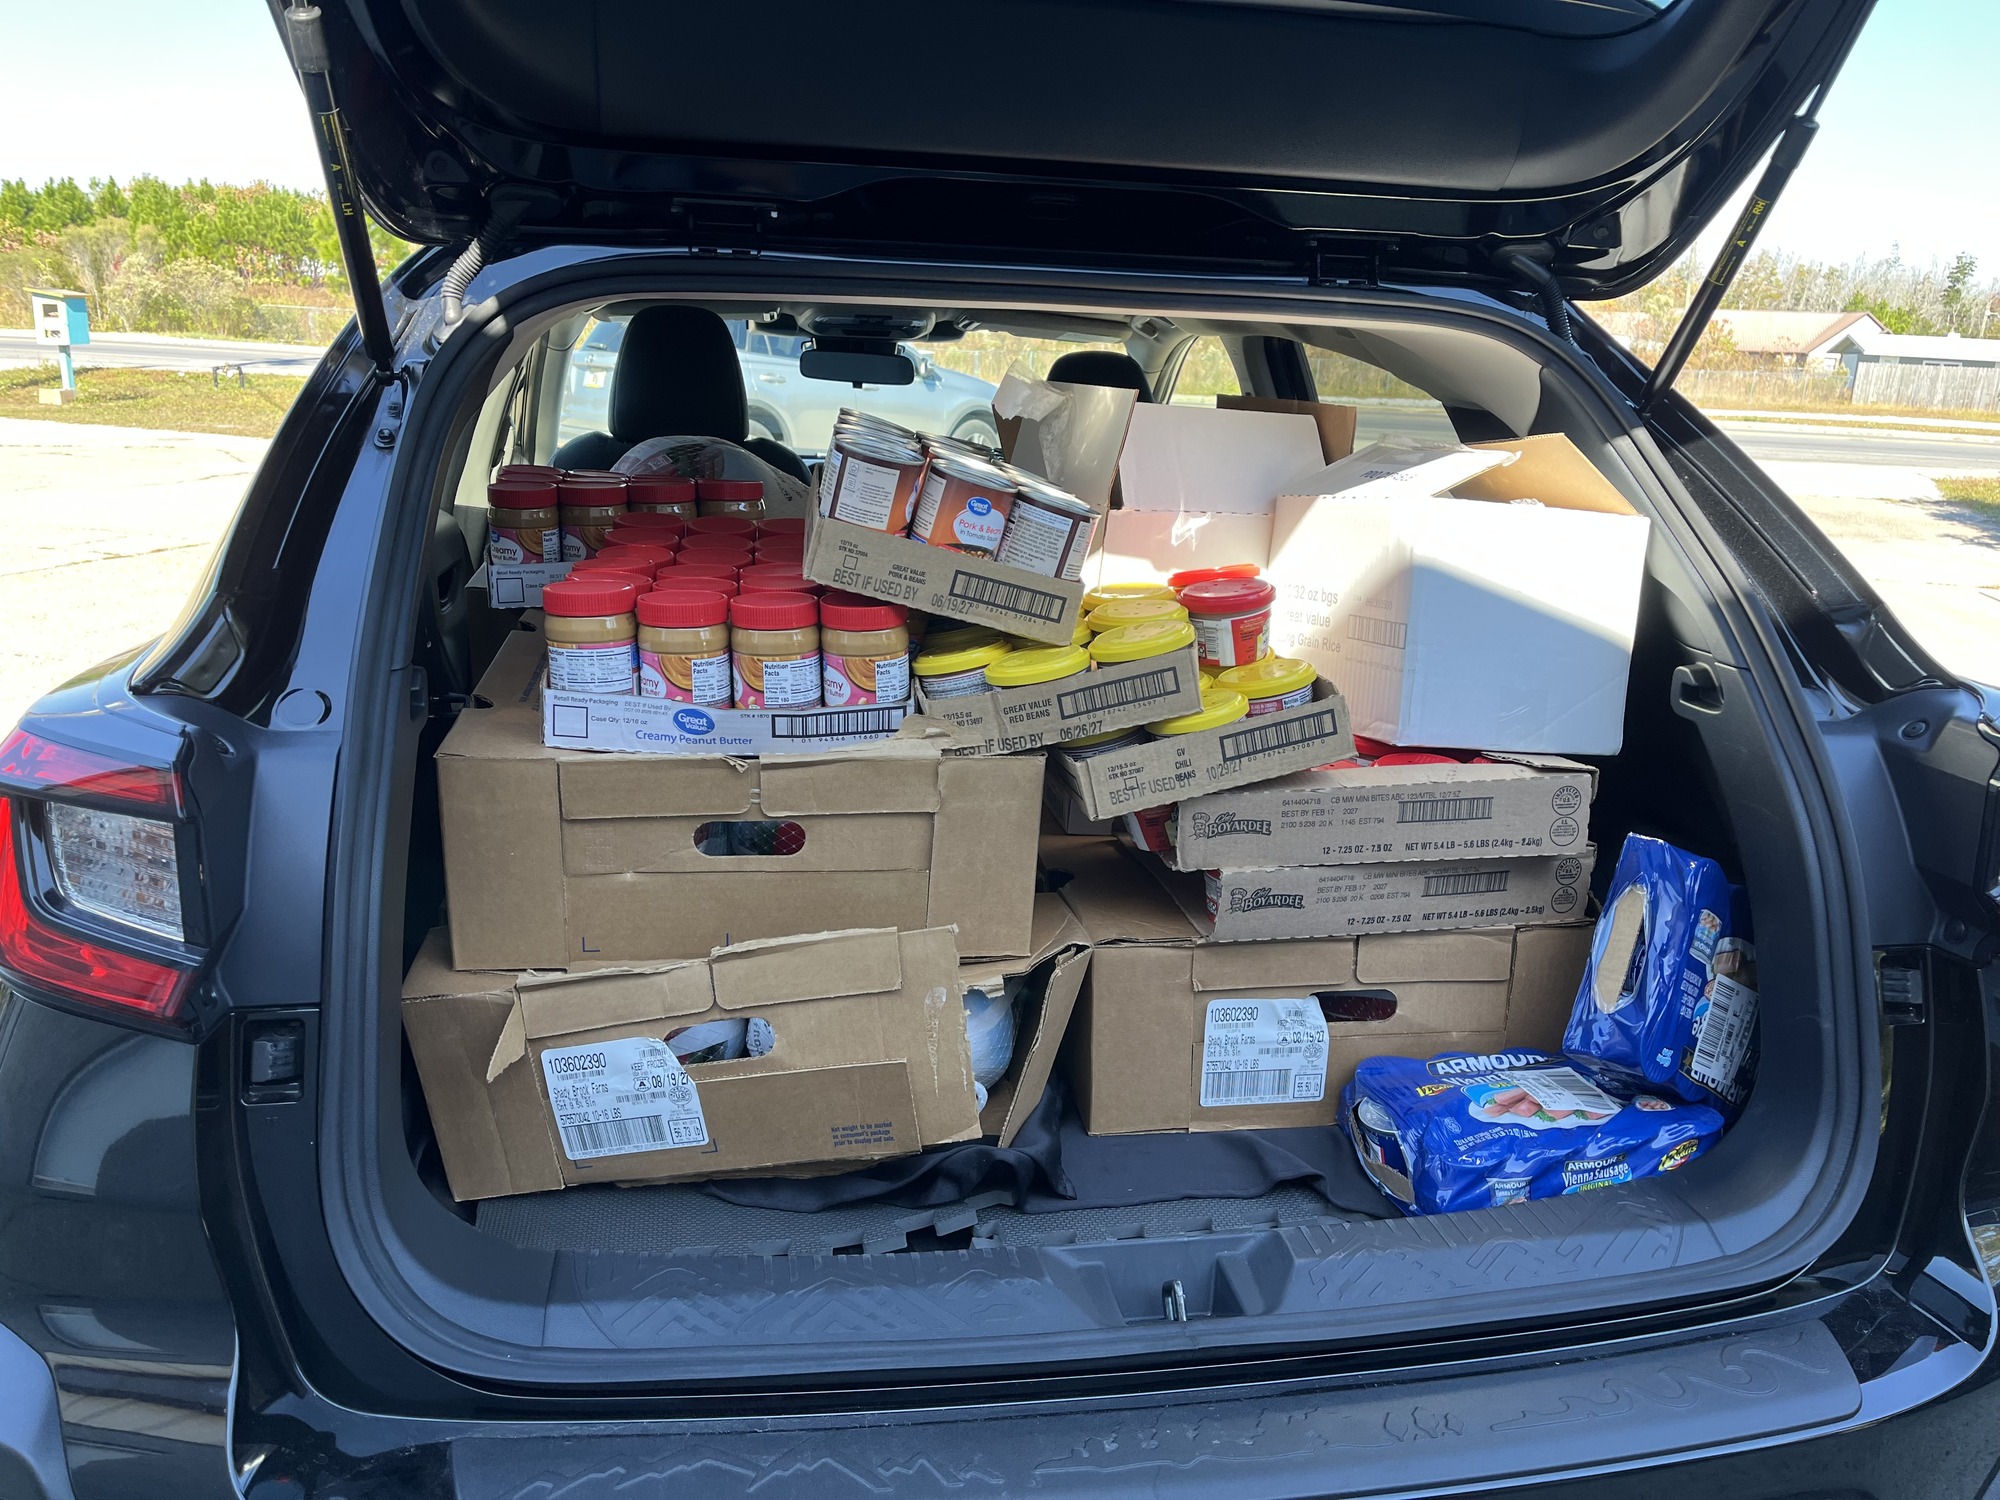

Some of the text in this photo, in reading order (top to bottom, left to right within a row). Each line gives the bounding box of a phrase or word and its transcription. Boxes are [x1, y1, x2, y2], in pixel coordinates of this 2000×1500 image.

[342, 202, 354, 216] LH
[1752, 200, 1766, 215] RH
[971, 500, 988, 510] Great
[959, 519, 978, 531] Pork
[966, 531, 985, 541] Tomato
[892, 564, 926, 577] GREAT VALUE
[833, 568, 919, 601] BEST IF USED BY
[888, 571, 926, 585] PORK BEANS
[931, 593, 972, 615] 06/19/27
[1308, 591, 1318, 600] oz
[1321, 588, 1338, 607] bgs
[985, 606, 1036, 624] 78742 37084
[1306, 612, 1331, 628] Value
[1298, 634, 1341, 652] Grain Rice
[571, 696, 588, 704] Ready
[589, 698, 618, 706] Packaging
[625, 701, 640, 709] BEST
[664, 704, 671, 712] By
[1003, 698, 1052, 716] GREAT VALUE
[1009, 709, 1051, 724] RED BEANS
[1103, 707, 1126, 716] 78742
[591, 715, 607, 723] Case
[623, 717, 639, 725] 12/16
[678, 713, 708, 726] Great
[966, 717, 983, 725] 13497
[685, 722, 708, 732] Value
[1060, 720, 1103, 741] 06/26/27
[635, 730, 753, 745] Creamy Peanut Butter
[985, 732, 1044, 754] IF USED BY
[1177, 748, 1185, 757] GV
[1175, 758, 1191, 769] CHILI
[1175, 770, 1196, 782] BEANS
[1109, 776, 1176, 805] BEST IF USED
[1282, 798, 1321, 806] 6414404718
[1215, 812, 1236, 823] Chef
[1207, 819, 1272, 839] BOYARDEE
[1354, 845, 1364, 853] OZ
[1405, 843, 1419, 851] NET
[1420, 842, 1432, 850] WT
[1434, 842, 1444, 850] 5.4
[1446, 841, 1455, 849] LB
[1476, 840, 1490, 848] LBS
[1251, 887, 1272, 899] Chef
[1317, 886, 1333, 894] BEST
[1242, 894, 1303, 912] BOYARDEE
[1348, 918, 1355, 926] 12
[1376, 916, 1385, 924] OZ
[1422, 913, 1435, 921] NET
[1436, 912, 1447, 920] WT
[1211, 1006, 1258, 1023] 103602390
[1225, 1035, 1239, 1045] Brook
[1242, 1034, 1256, 1044] Farms
[549, 1052, 606, 1075] 103602390
[1234, 1060, 1248, 1069] 10-16
[1250, 1059, 1259, 1068] LBS
[652, 1072, 689, 1088] 08/19/27
[553, 1083, 609, 1100] Shady Brook Farms
[560, 1108, 622, 1126] 575570042 10-16 LBS
[694, 1126, 701, 1136] lb
[1568, 1156, 1617, 1171] ARMOUR
[1562, 1162, 1629, 1188] Vienna Sausage
[1578, 1180, 1612, 1192] ORIGINAL
